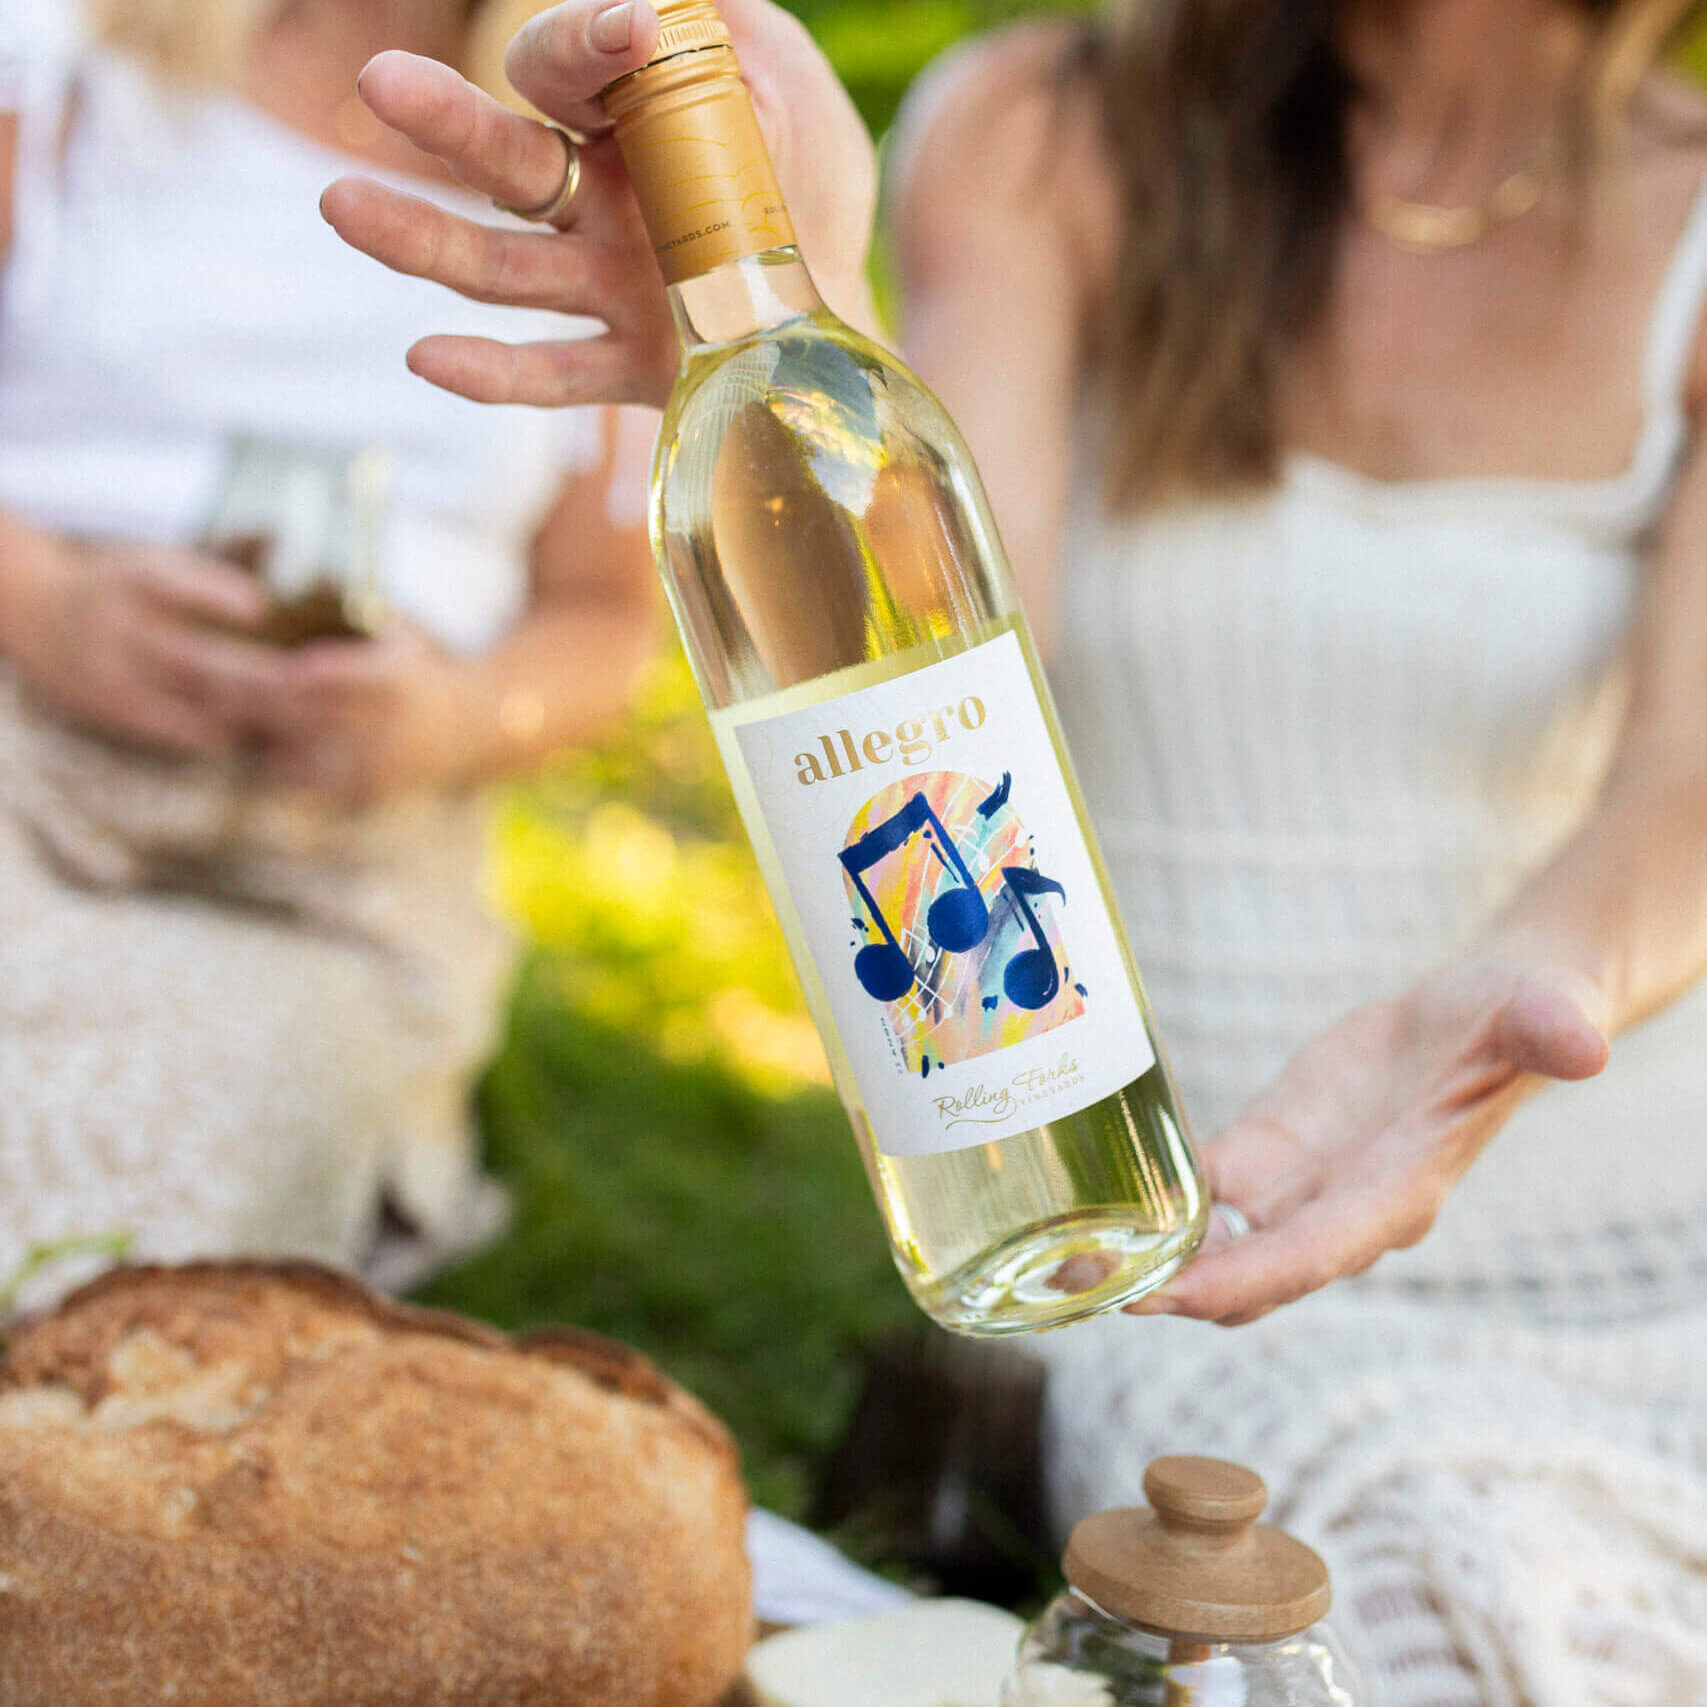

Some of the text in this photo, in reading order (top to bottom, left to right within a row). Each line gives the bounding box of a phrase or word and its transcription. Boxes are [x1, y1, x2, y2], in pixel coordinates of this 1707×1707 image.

[794, 695, 986, 787] allegro
[933, 1052, 1079, 1130] Rolling Forks
